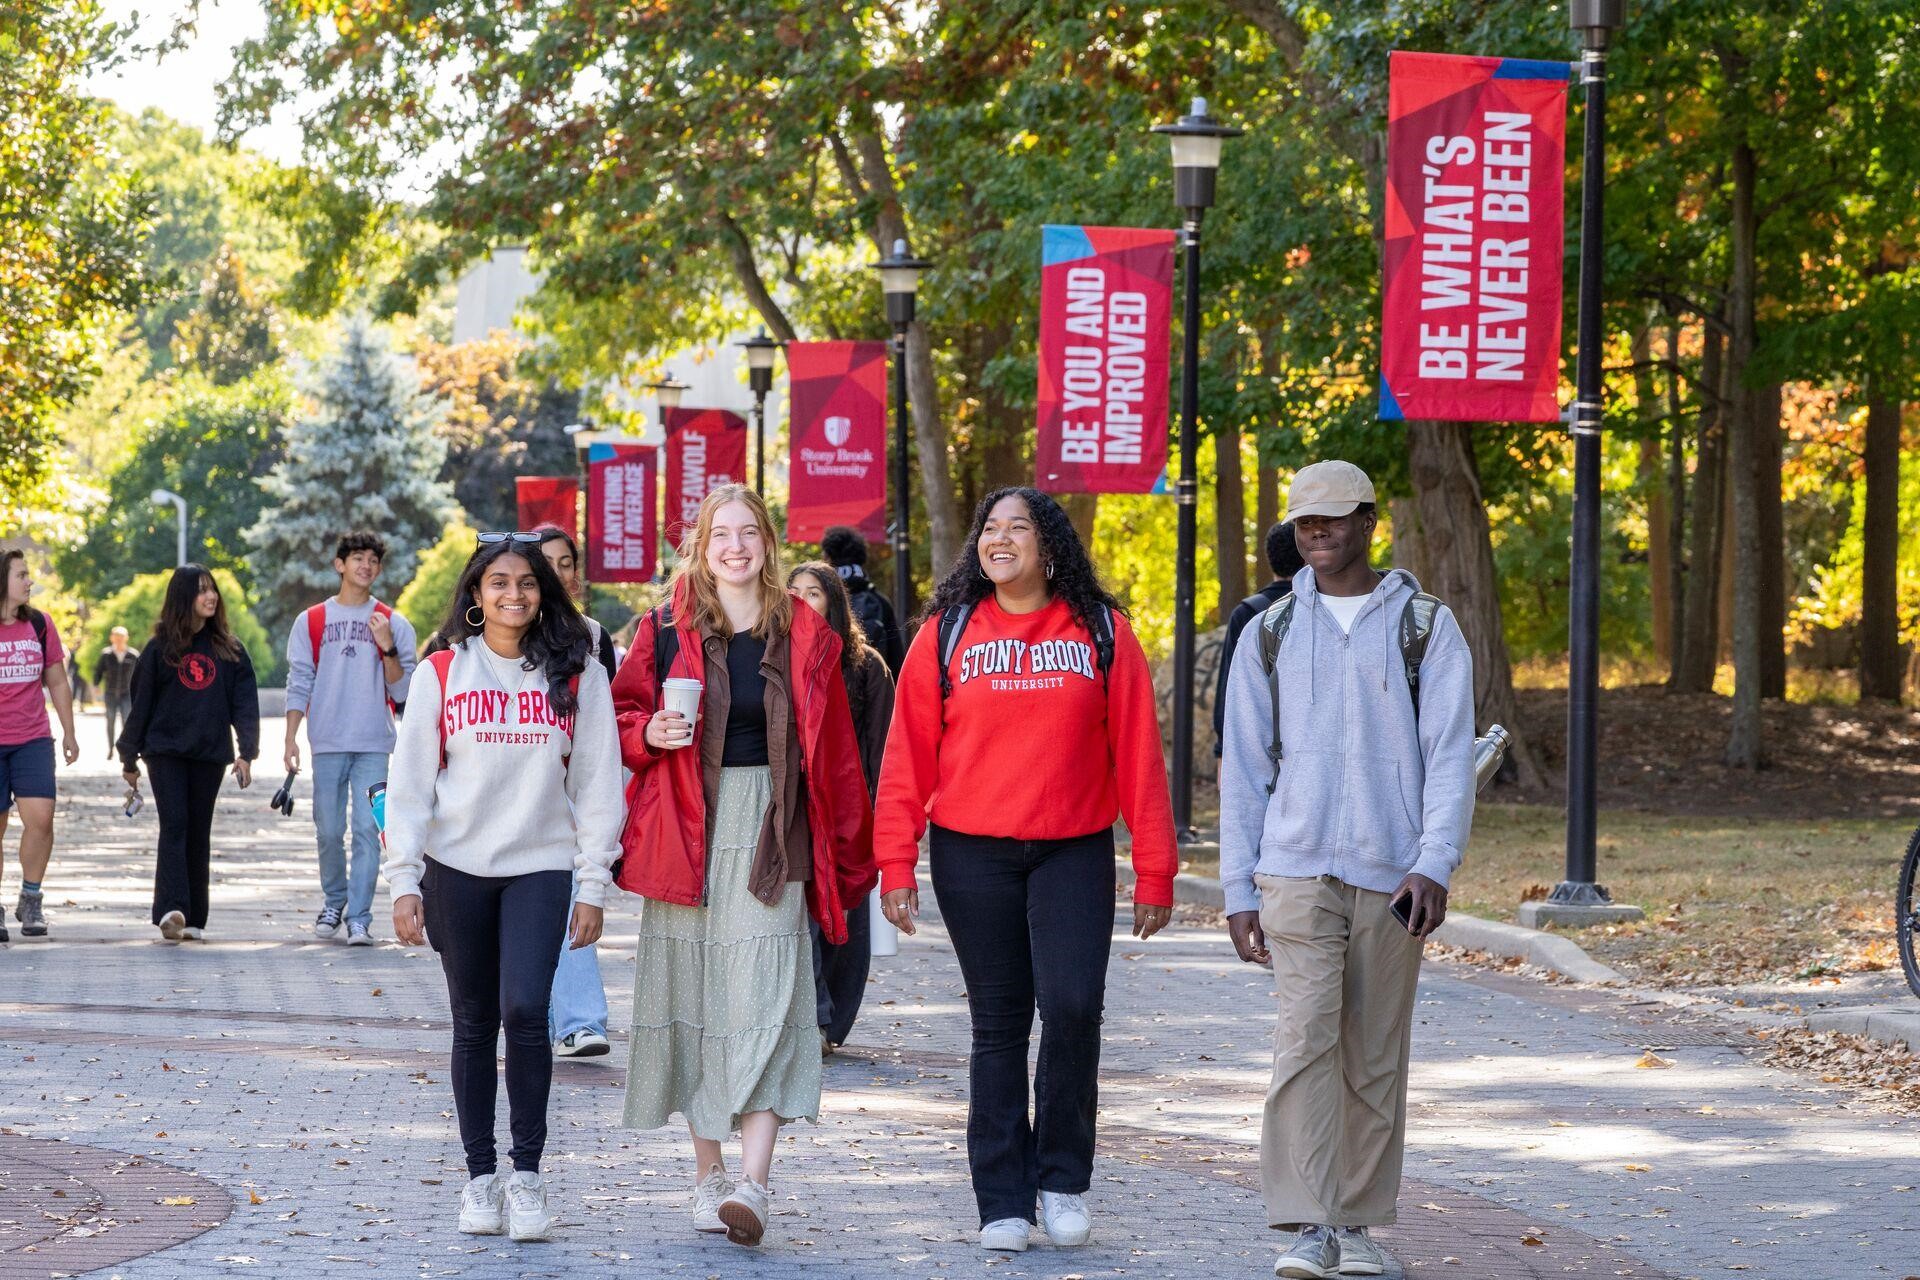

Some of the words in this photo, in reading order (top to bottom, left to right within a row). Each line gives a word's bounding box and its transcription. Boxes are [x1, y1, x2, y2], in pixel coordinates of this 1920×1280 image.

[1481, 111, 1533, 223] BEEN
[1420, 134, 1476, 311] WHAT'S
[1065, 267, 1106, 339] AND
[1475, 237, 1529, 381] NEVER
[1418, 322, 1470, 380] BE
[1062, 345, 1103, 413] YOU
[1103, 291, 1148, 464] IMPROVED
[800, 447, 836, 466] Stony
[837, 448, 875, 463] Brook
[1061, 420, 1100, 464] BE
[806, 462, 869, 479] University
[603, 465, 624, 547] ANYTHING
[624, 461, 645, 536] AVERAGE
[603, 547, 623, 569] BE
[624, 536, 645, 570] BUT
[959, 638, 1027, 684] STONY
[1029, 639, 1095, 681] BROOK
[991, 676, 1065, 690] UNIVERSITY
[445, 689, 510, 736] STONY
[475, 731, 550, 745] UNIVERSITY
